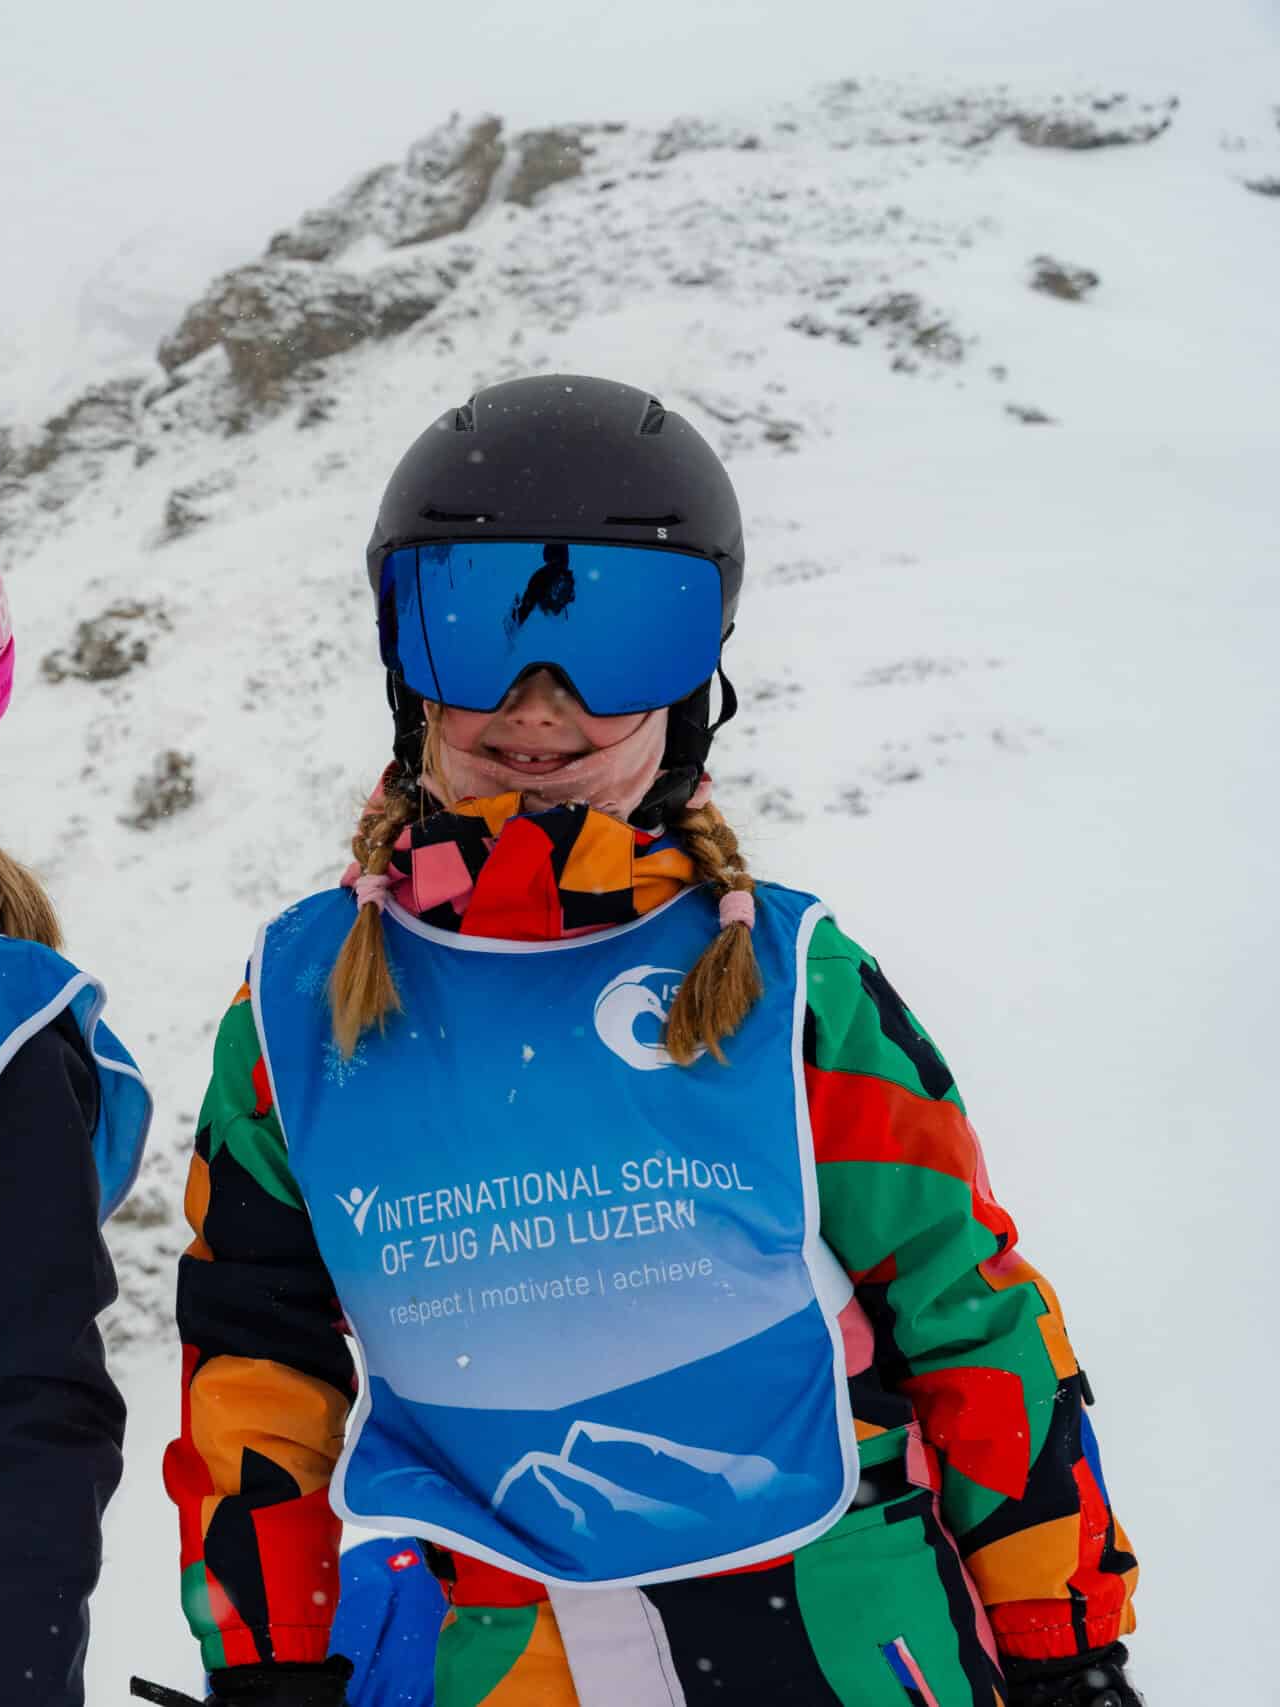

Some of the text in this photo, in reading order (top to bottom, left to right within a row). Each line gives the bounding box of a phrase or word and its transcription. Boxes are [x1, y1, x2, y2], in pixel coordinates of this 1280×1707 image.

[377, 1156, 754, 1233] INTERNATIONAL SCHOOL
[381, 1199, 696, 1275] OF ZUG AND LUZERN
[389, 1291, 463, 1328] respect
[480, 1274, 590, 1310] motivate
[612, 1256, 713, 1291] achieve
